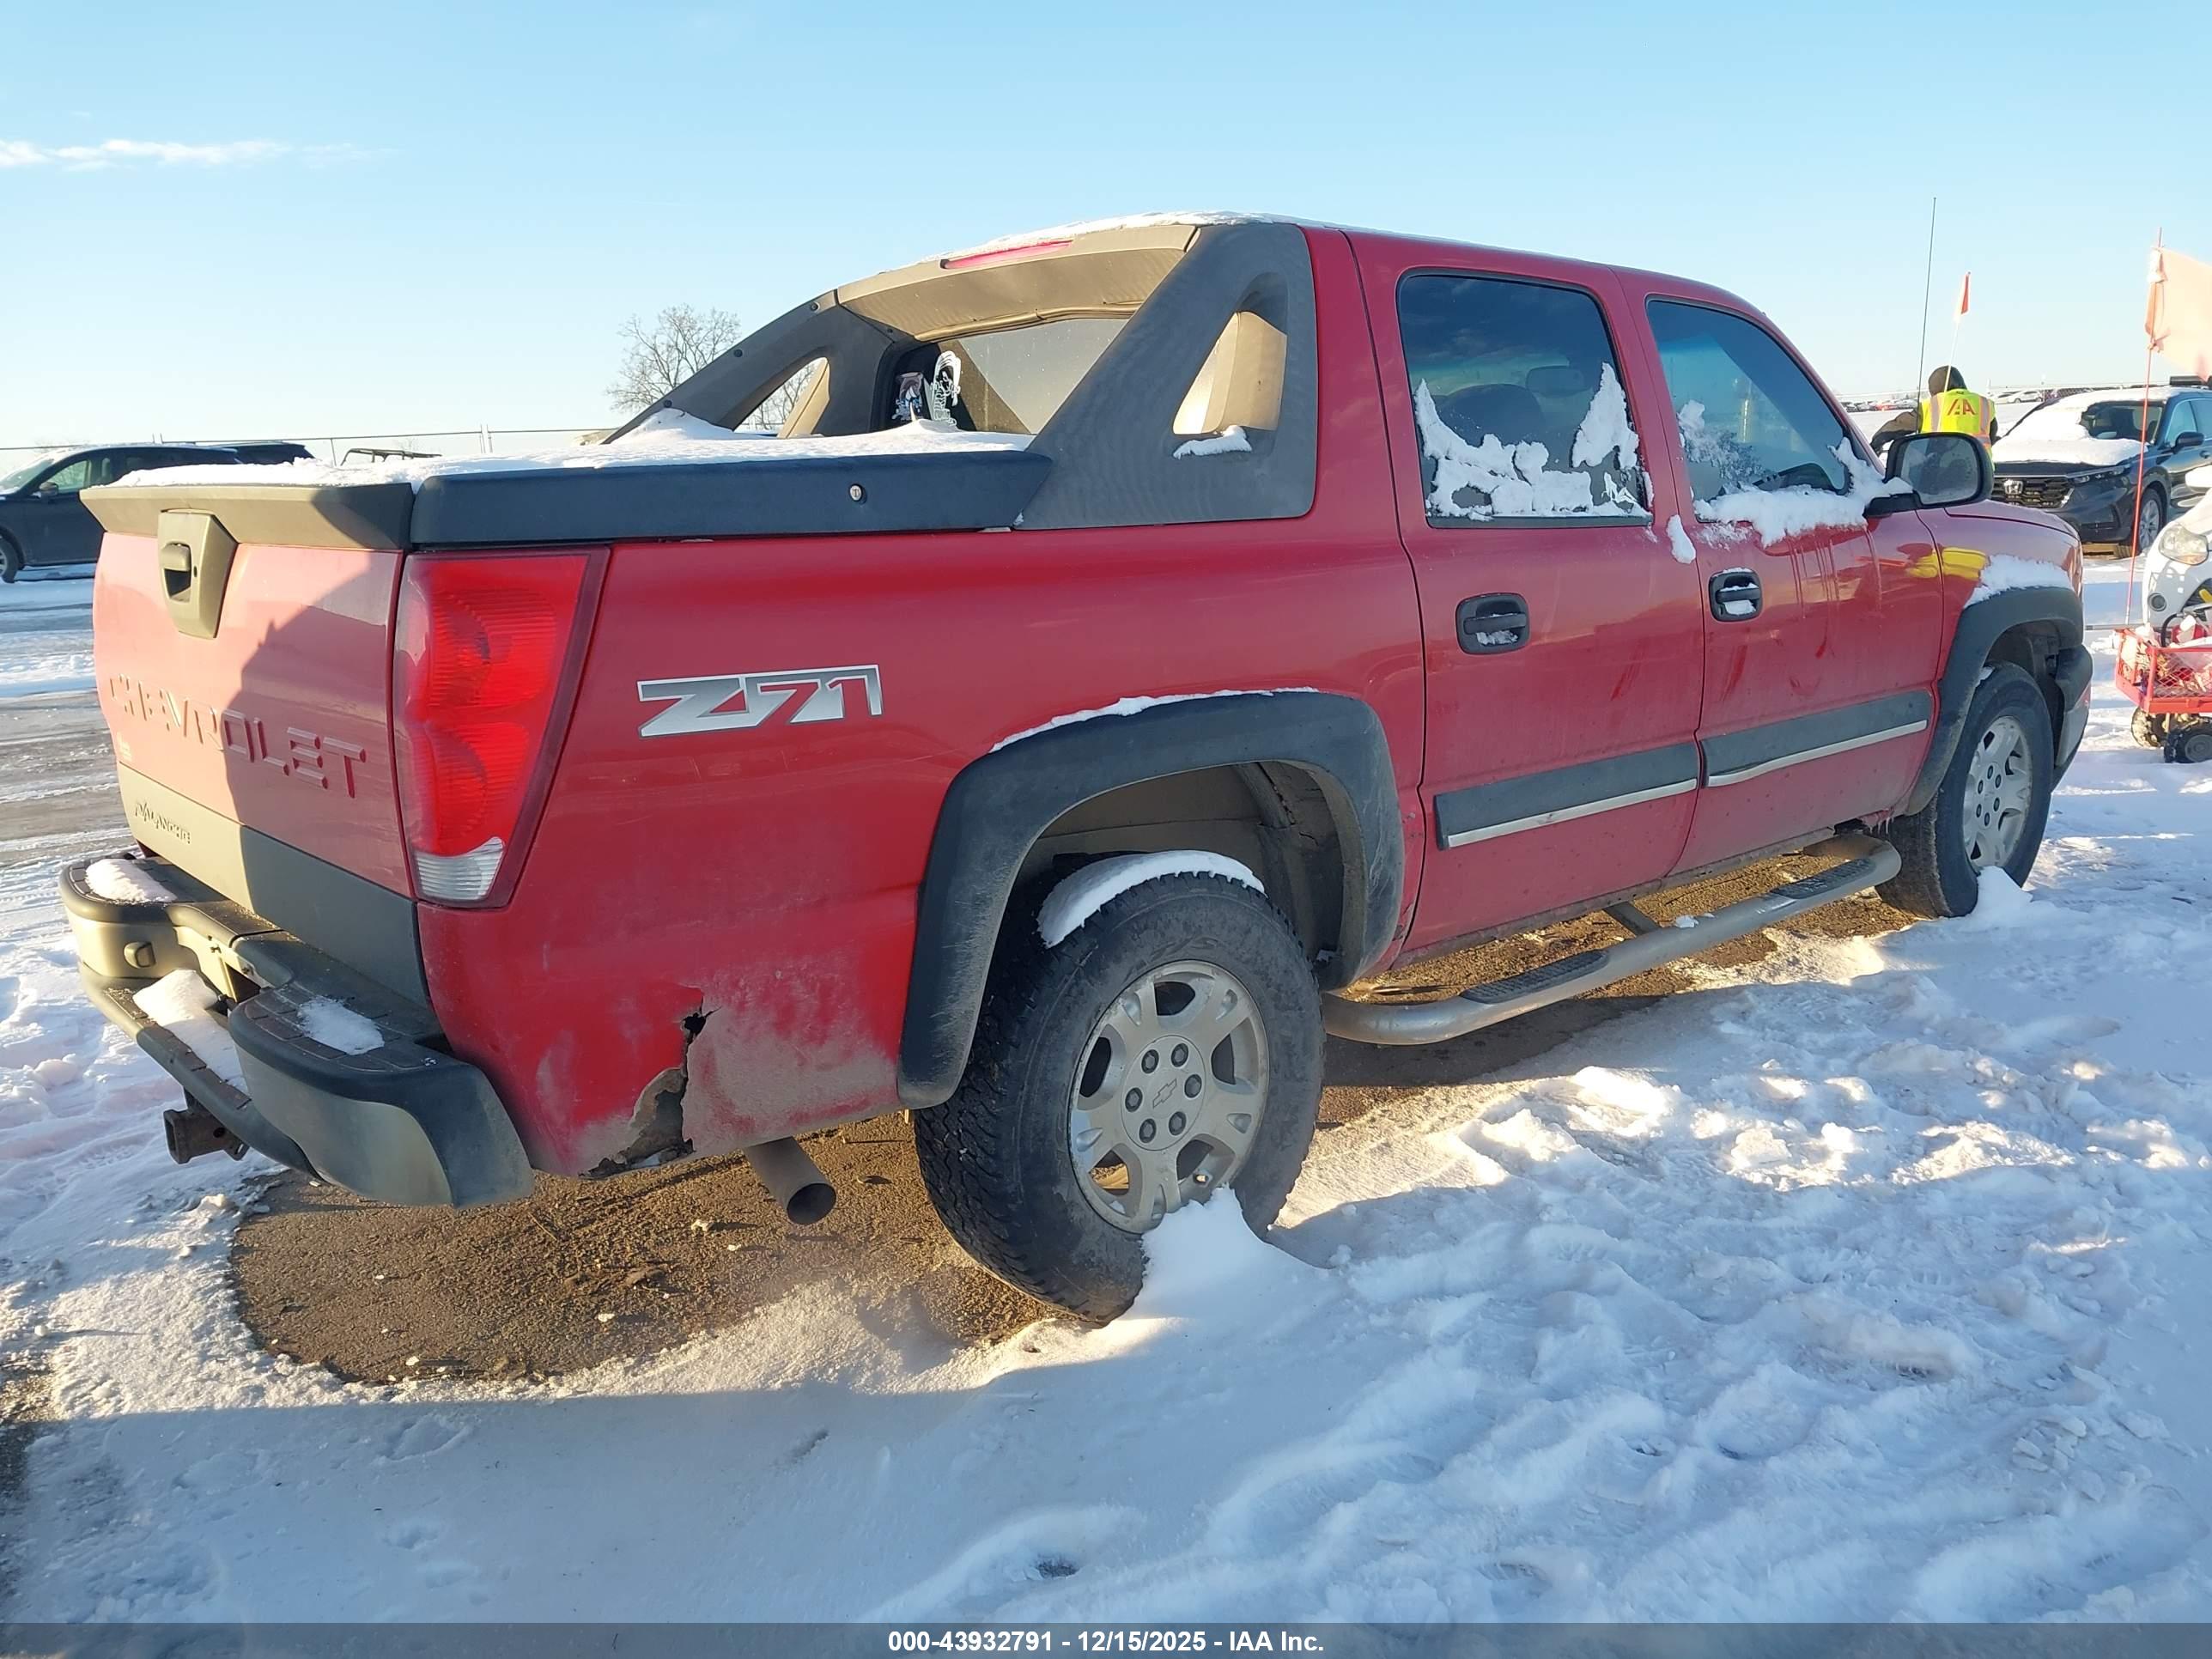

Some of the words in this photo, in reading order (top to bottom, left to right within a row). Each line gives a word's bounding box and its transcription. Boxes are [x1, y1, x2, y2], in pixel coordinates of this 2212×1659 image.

[109, 673, 367, 799] CHEVROLET
[637, 664, 883, 737] Z71
[134, 800, 192, 846] AVALANCHE
